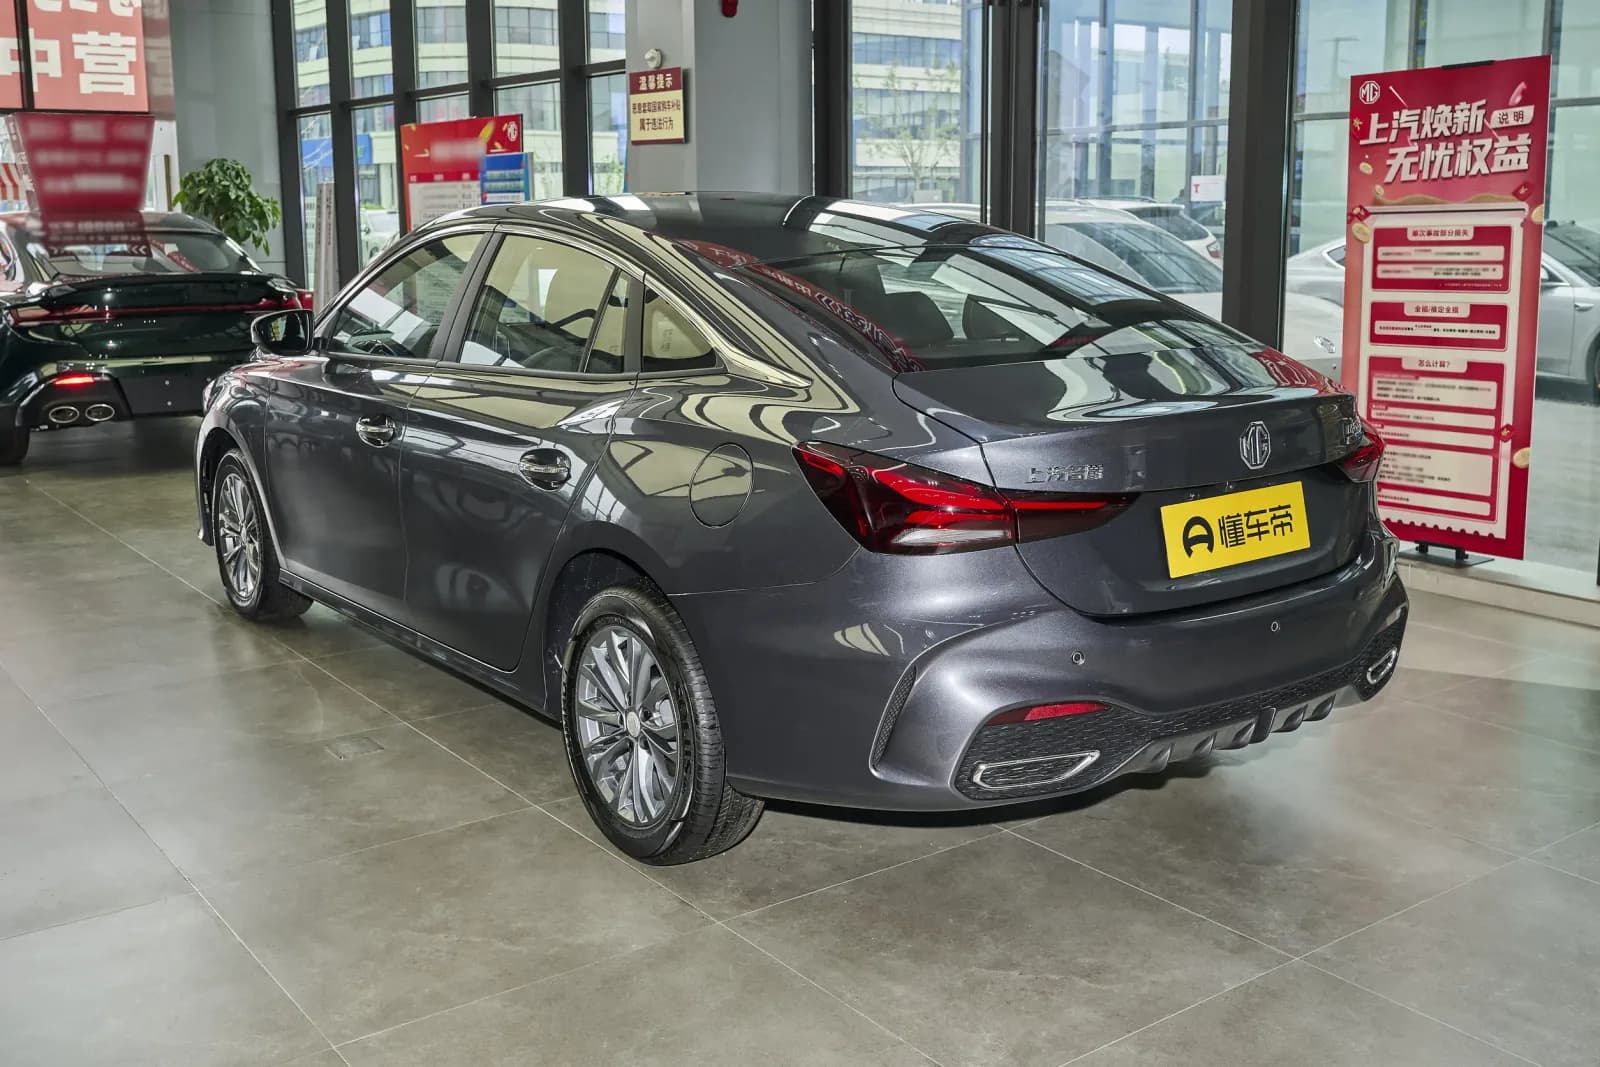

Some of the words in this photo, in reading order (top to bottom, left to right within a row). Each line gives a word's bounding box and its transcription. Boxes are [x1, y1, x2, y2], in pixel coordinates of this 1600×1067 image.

[639, 73, 673, 91] 温馨提示
[1359, 81, 1381, 105] MG
[1359, 99, 1487, 146] 上汽焕新
[1499, 110, 1525, 125] 说明
[1383, 132, 1533, 184] 无忧权益
[1239, 420, 1272, 470] MG
[1217, 504, 1294, 549] 懂车帝
